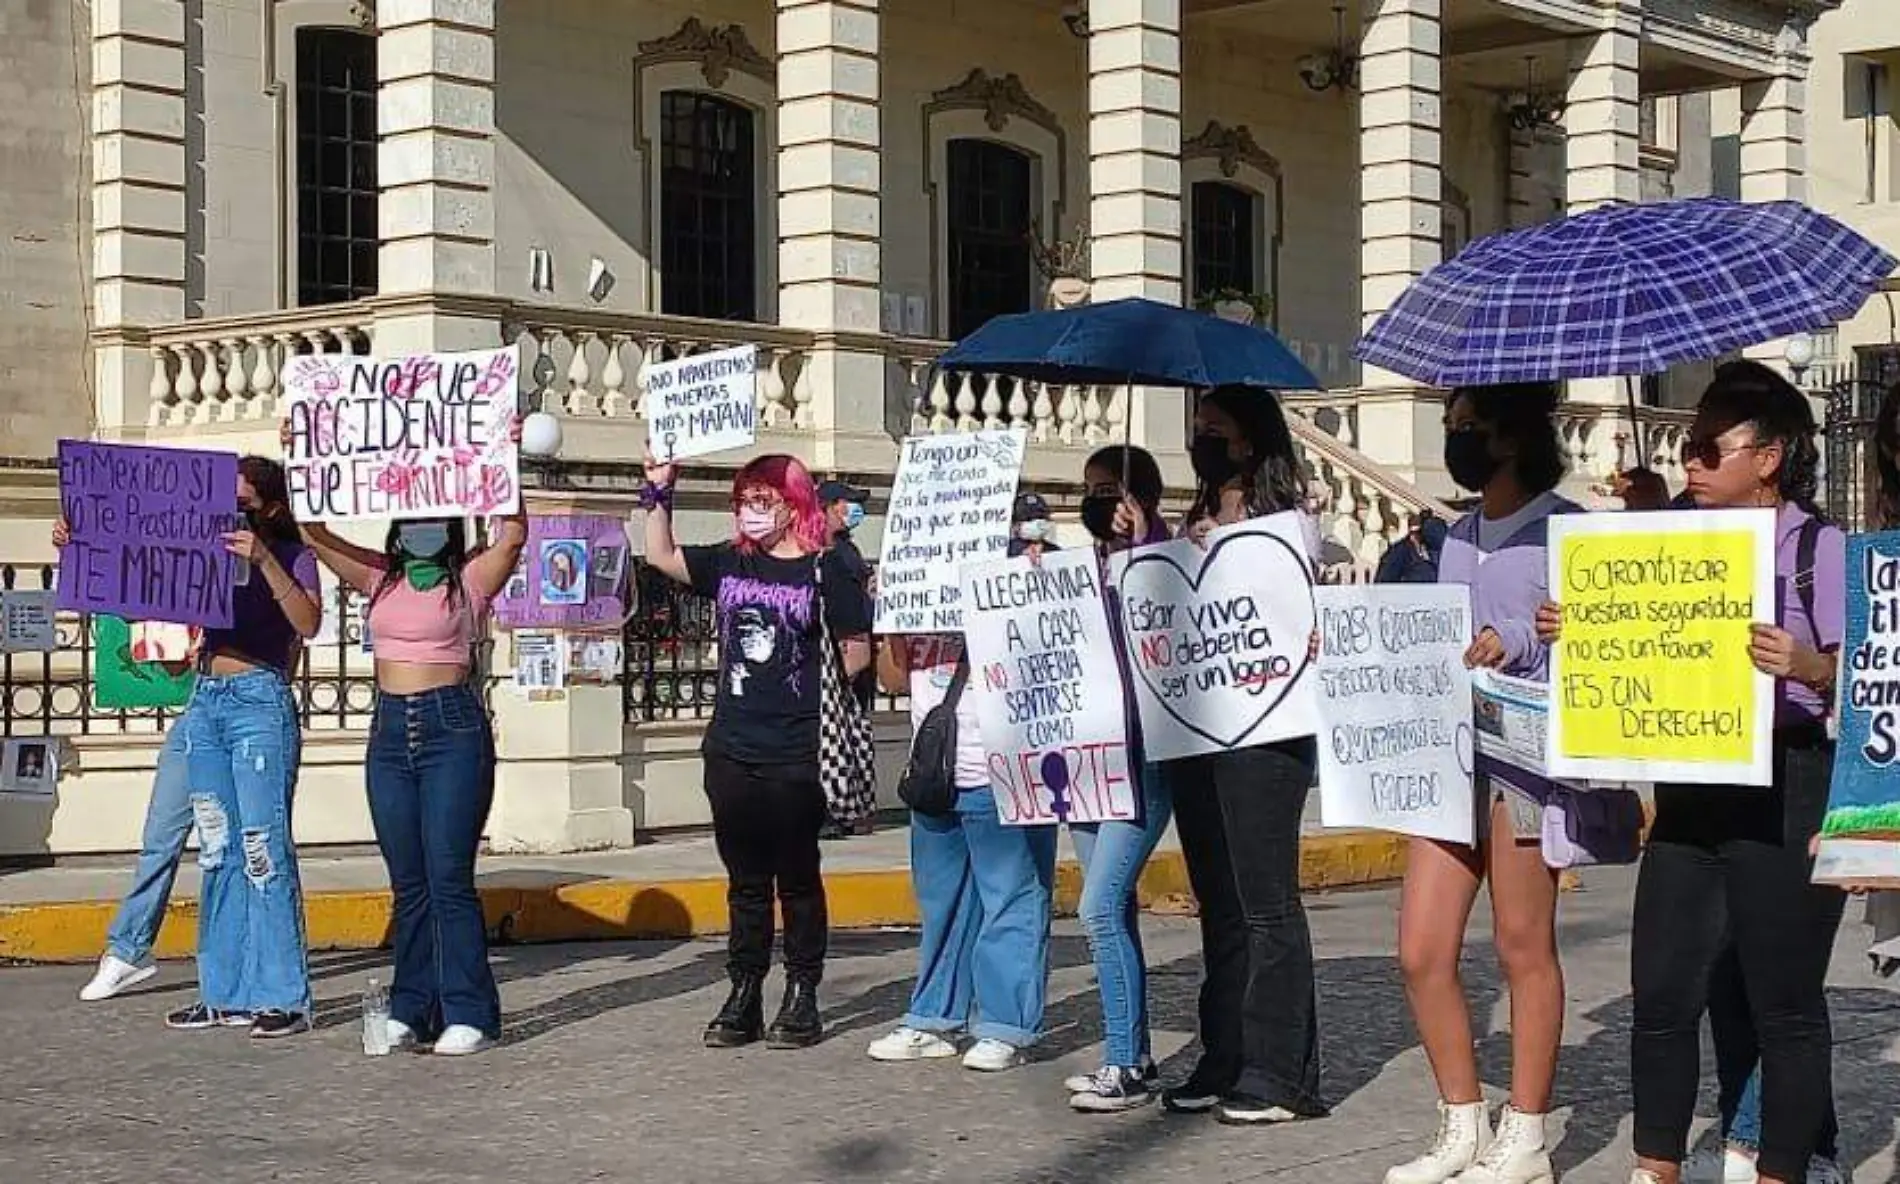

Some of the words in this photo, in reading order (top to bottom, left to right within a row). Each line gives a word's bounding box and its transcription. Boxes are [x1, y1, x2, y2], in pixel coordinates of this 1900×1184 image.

[665, 384, 729, 409] MUERTAS
[290, 397, 491, 459] ACCIDENTE
[656, 412, 684, 433] NOS
[690, 400, 752, 438] MATAN!
[91, 449, 179, 494] Mexico
[907, 440, 954, 469] Tengo
[87, 493, 116, 534] Te
[929, 512, 955, 535] que
[961, 510, 980, 524] no
[984, 508, 1007, 522] me
[72, 538, 106, 602] TE
[120, 543, 231, 619] MATAN
[911, 590, 936, 609] ME
[1128, 596, 1176, 630] Estar
[1007, 619, 1026, 652] A
[1039, 607, 1088, 649] CASA
[1140, 634, 1171, 669] NO
[1567, 639, 1592, 660] no
[1599, 639, 1625, 662] es
[1631, 638, 1657, 659] un
[1852, 639, 1887, 671] de
[984, 662, 1008, 692] NO
[1161, 672, 1188, 699] ser
[1196, 665, 1227, 692] un
[1228, 655, 1291, 695] logro
[1611, 676, 1653, 706] UN
[1005, 681, 1083, 725] SENTIRSE
[1027, 716, 1075, 749] COMO
[1621, 707, 1743, 738] DERECHO!
[1863, 711, 1898, 765] S
[987, 741, 1129, 822] SUERTE
